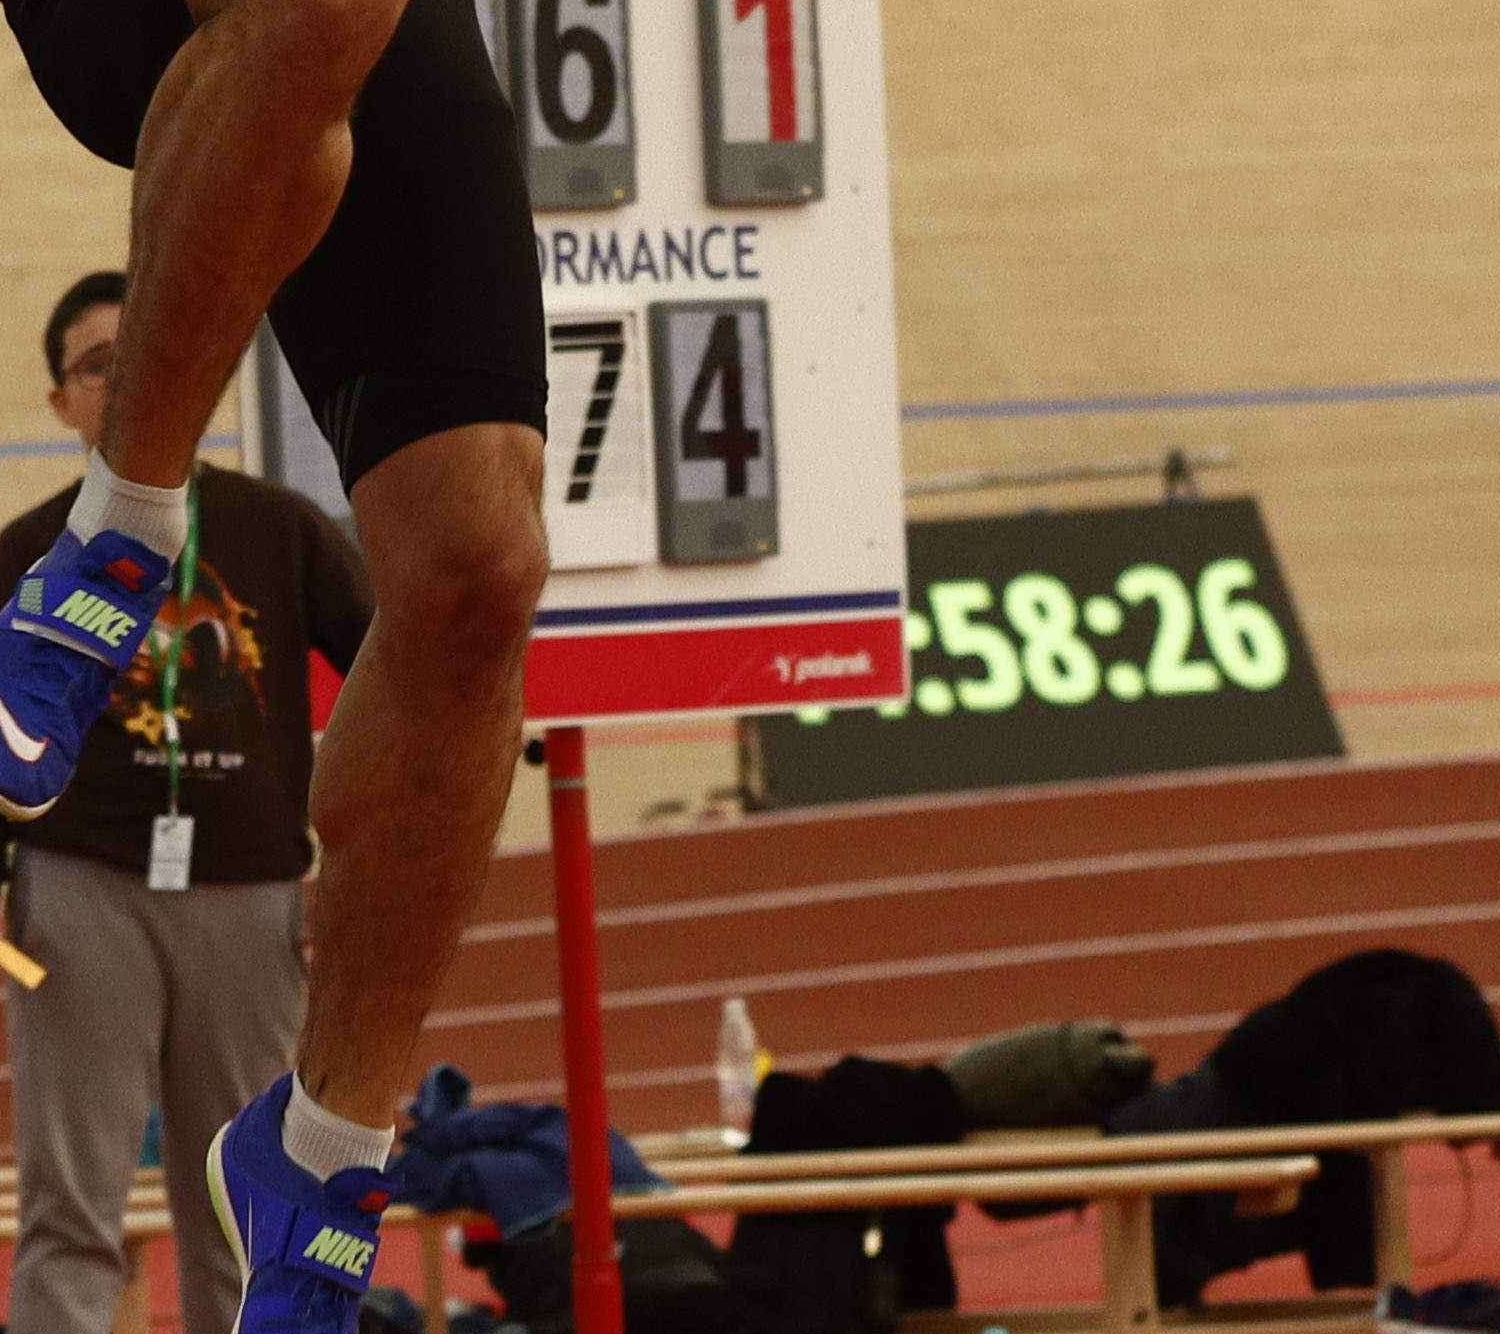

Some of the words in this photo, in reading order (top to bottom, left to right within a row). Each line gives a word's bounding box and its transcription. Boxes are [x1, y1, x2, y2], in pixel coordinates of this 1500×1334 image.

[52, 589, 138, 648] NIKE
[904, 557, 1289, 715] :58:26
[302, 1224, 375, 1278] NIKE
